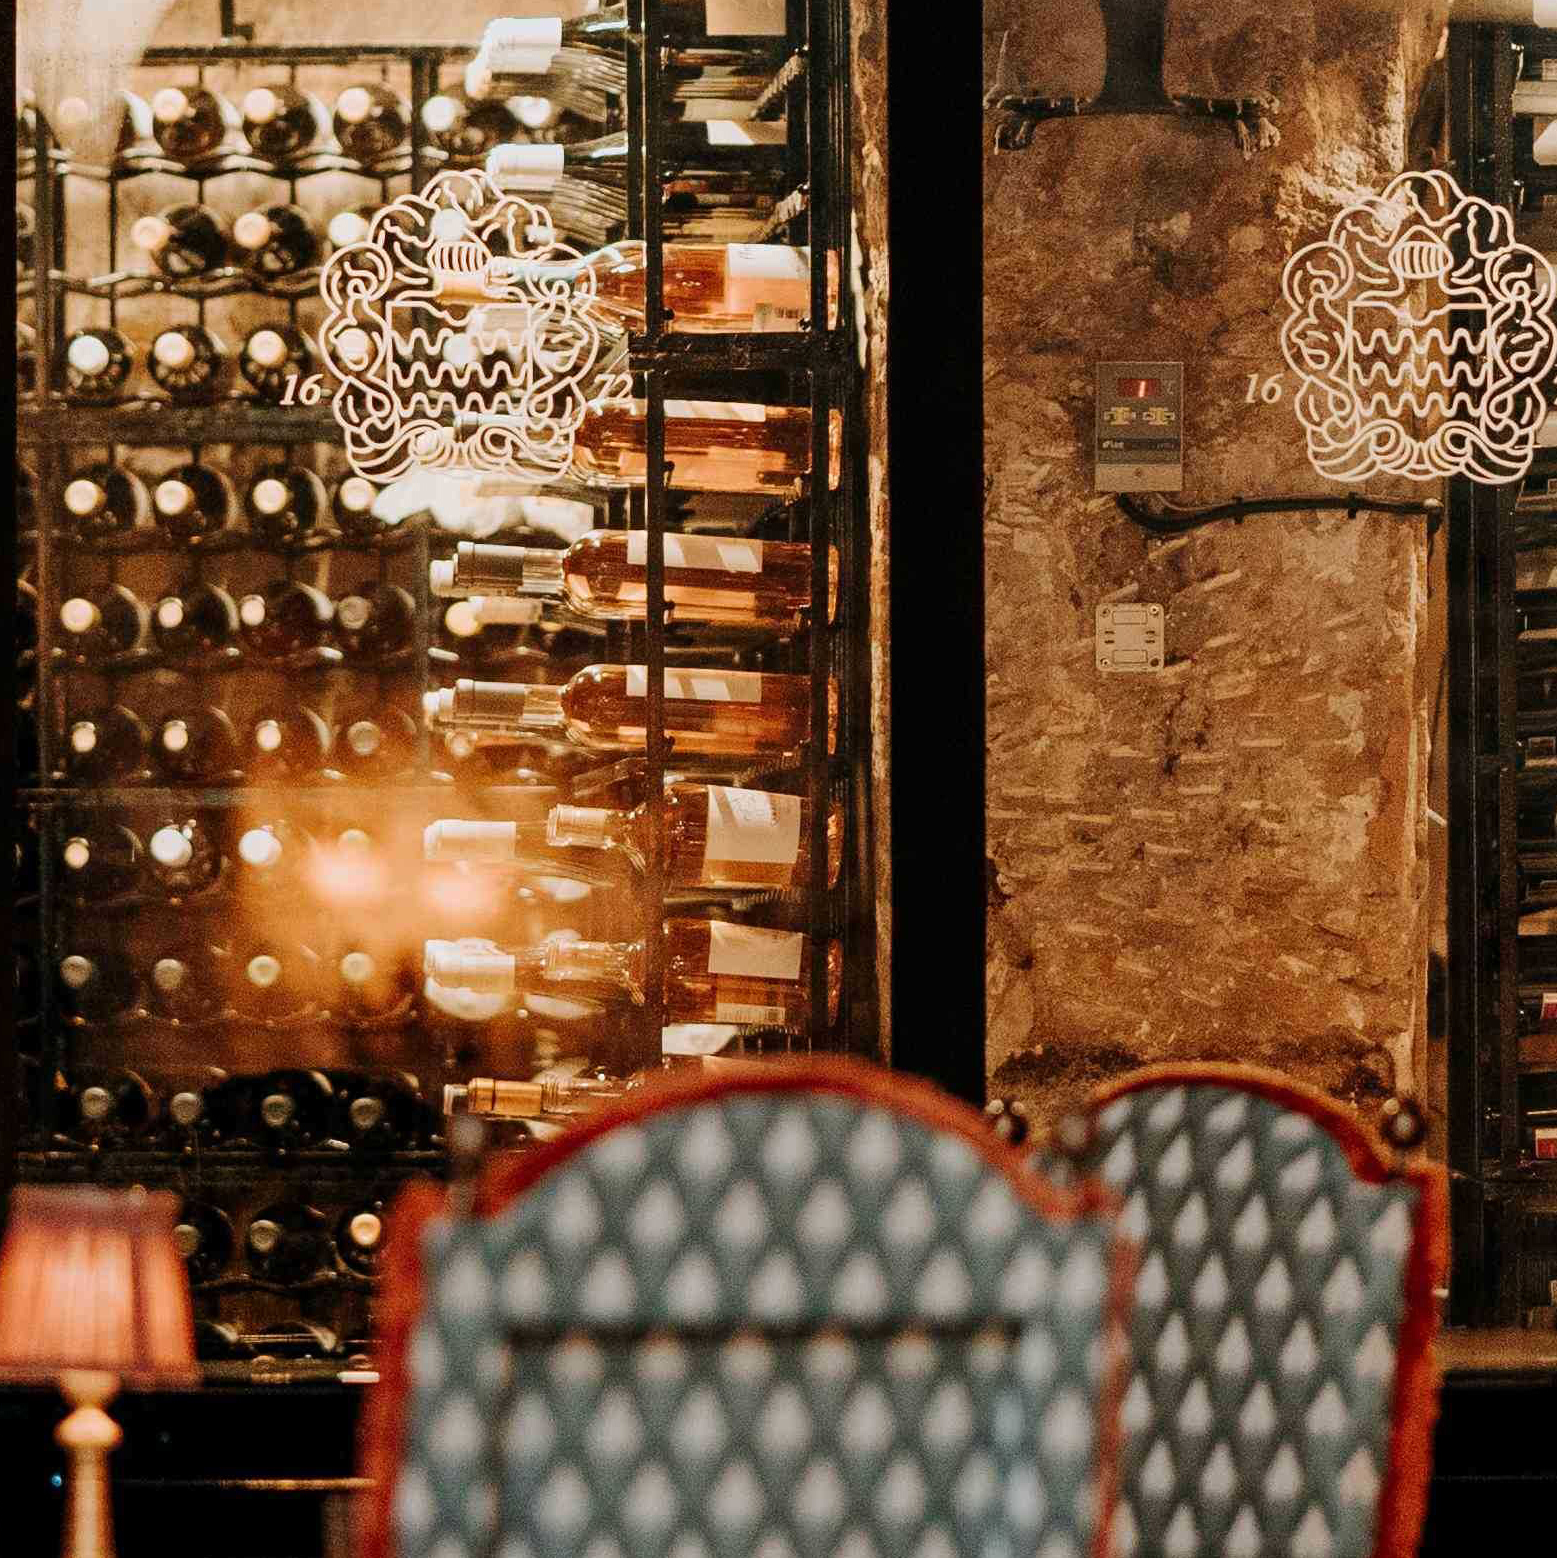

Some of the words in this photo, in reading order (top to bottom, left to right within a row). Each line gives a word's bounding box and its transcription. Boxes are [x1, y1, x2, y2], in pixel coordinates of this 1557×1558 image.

[279, 373, 324, 405] 16
[594, 373, 633, 404] 72
[1244, 373, 1284, 403] 16
